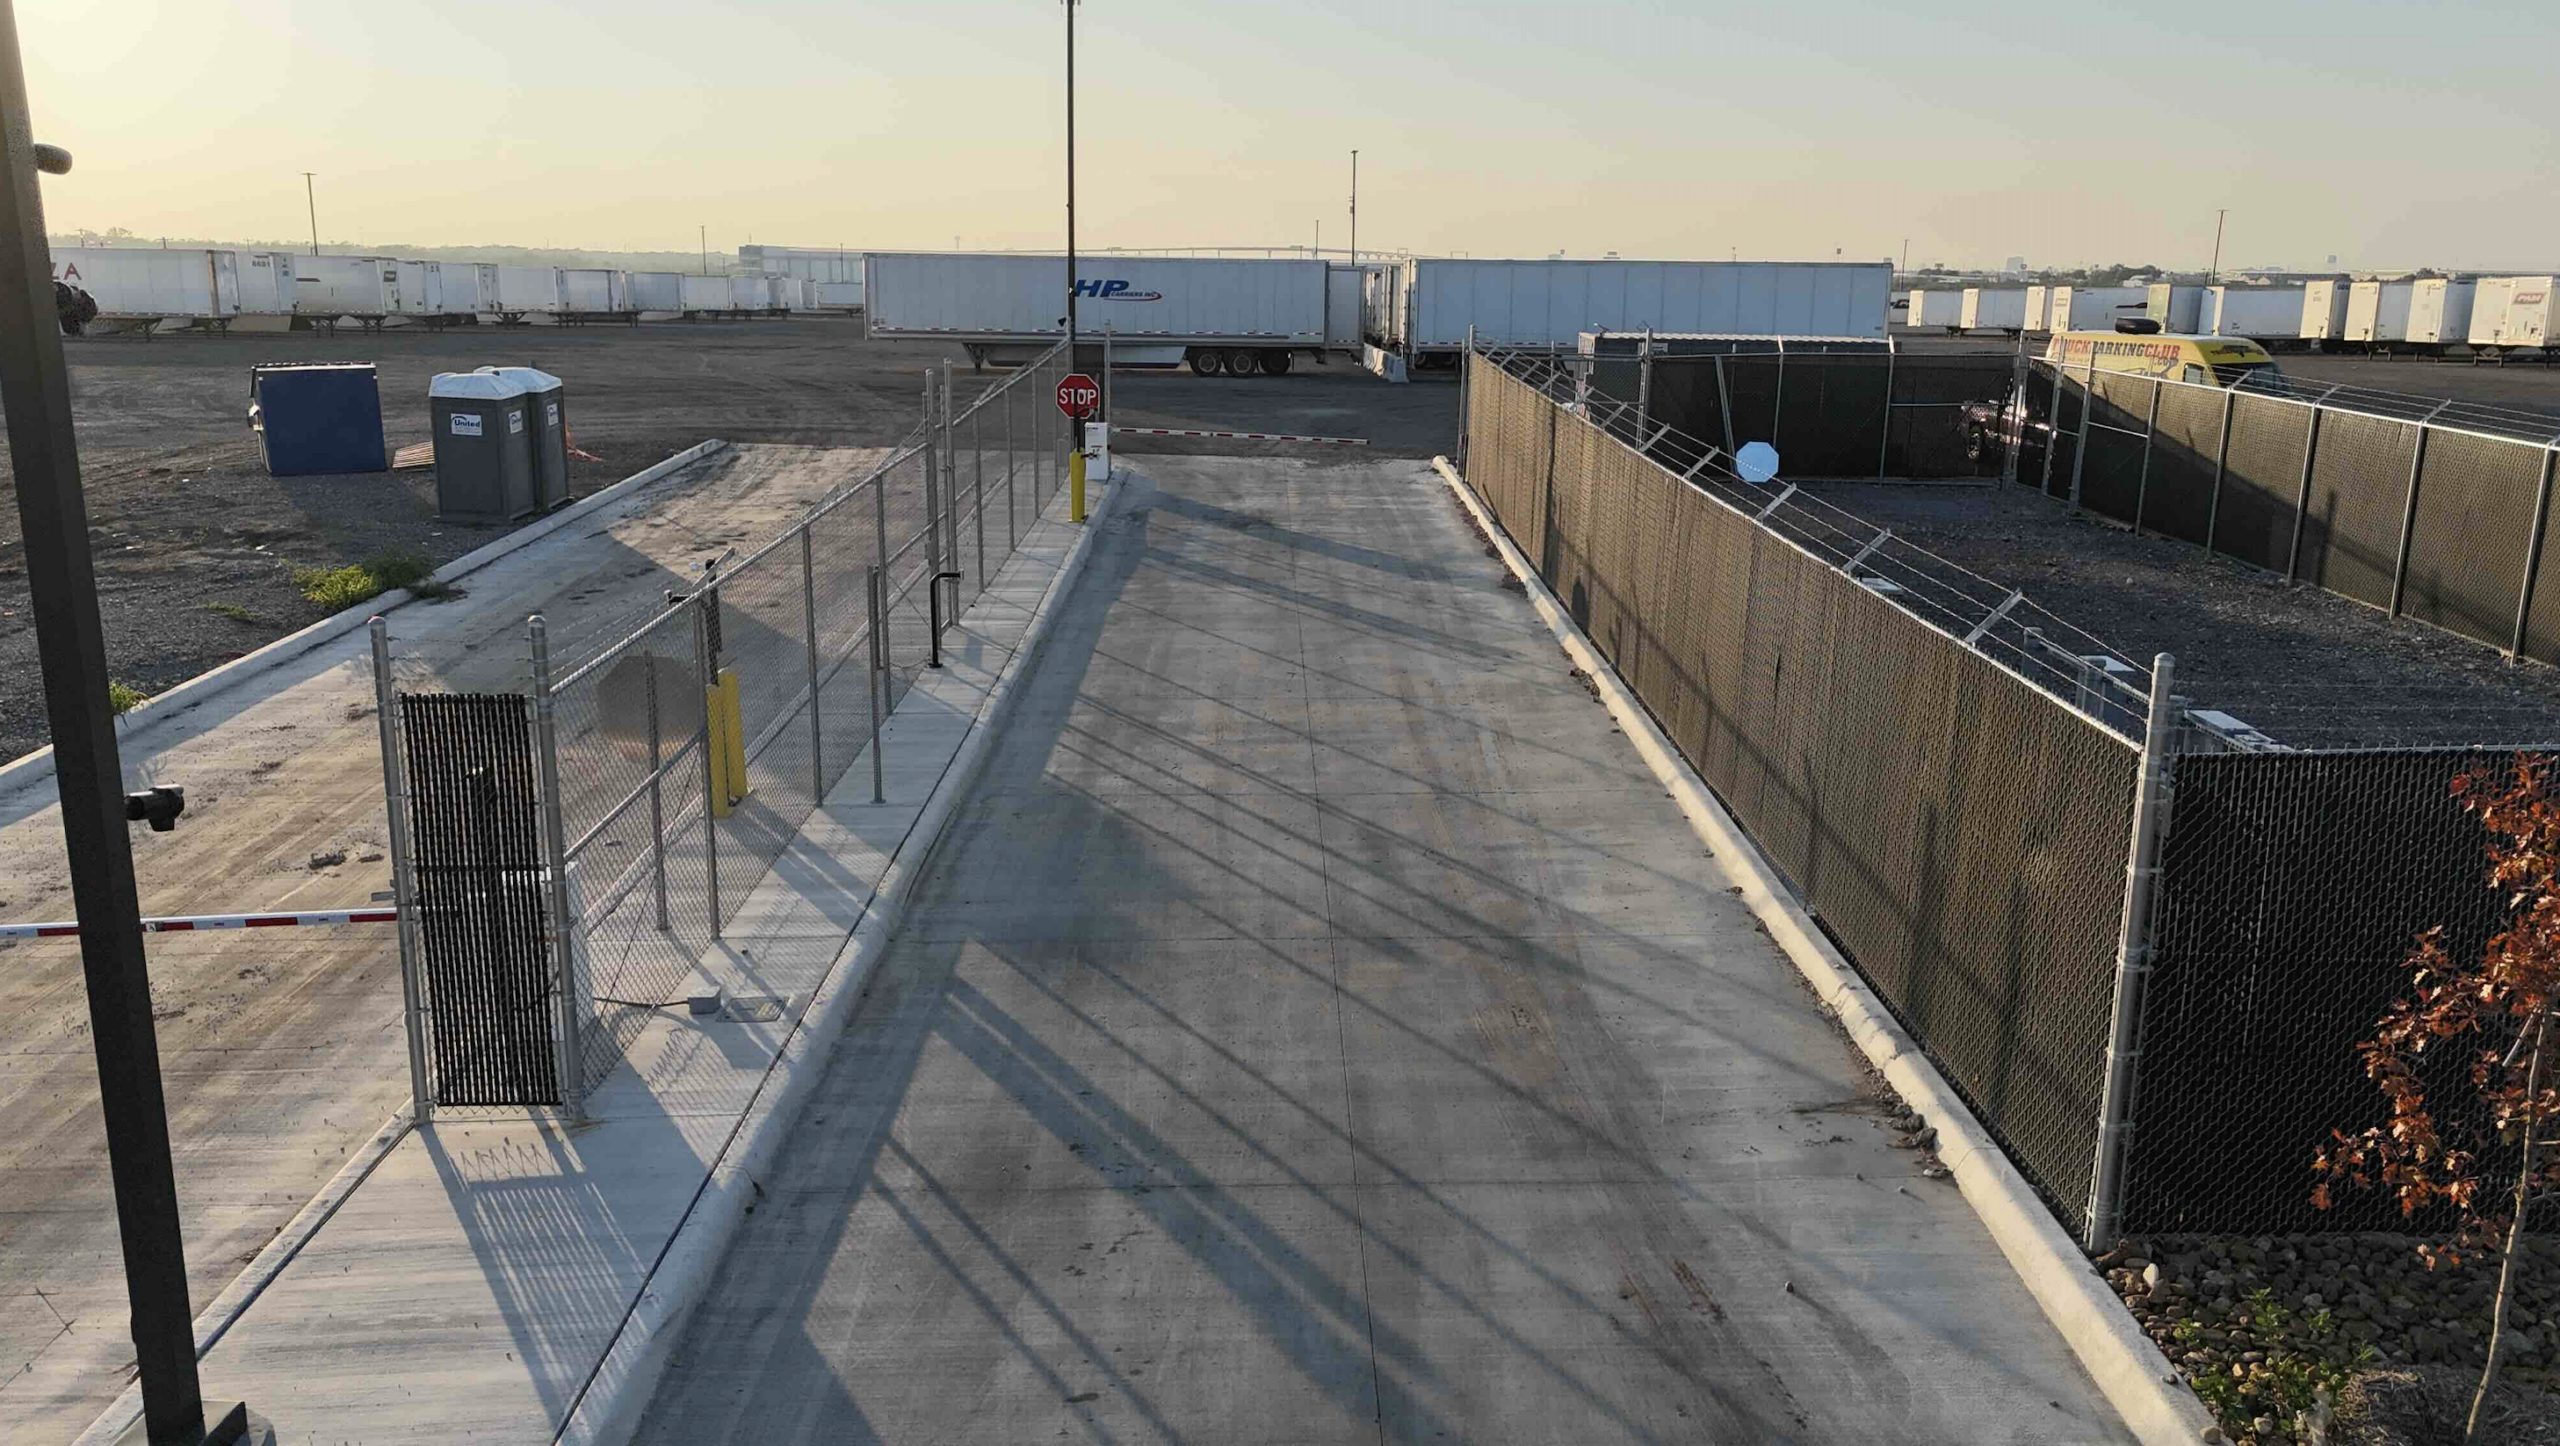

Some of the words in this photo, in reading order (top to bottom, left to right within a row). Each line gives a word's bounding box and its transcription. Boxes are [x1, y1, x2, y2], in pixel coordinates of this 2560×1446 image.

[1074, 280, 1129, 297] HP
[1059, 388, 1096, 405] STOP
[454, 419, 480, 428] United
